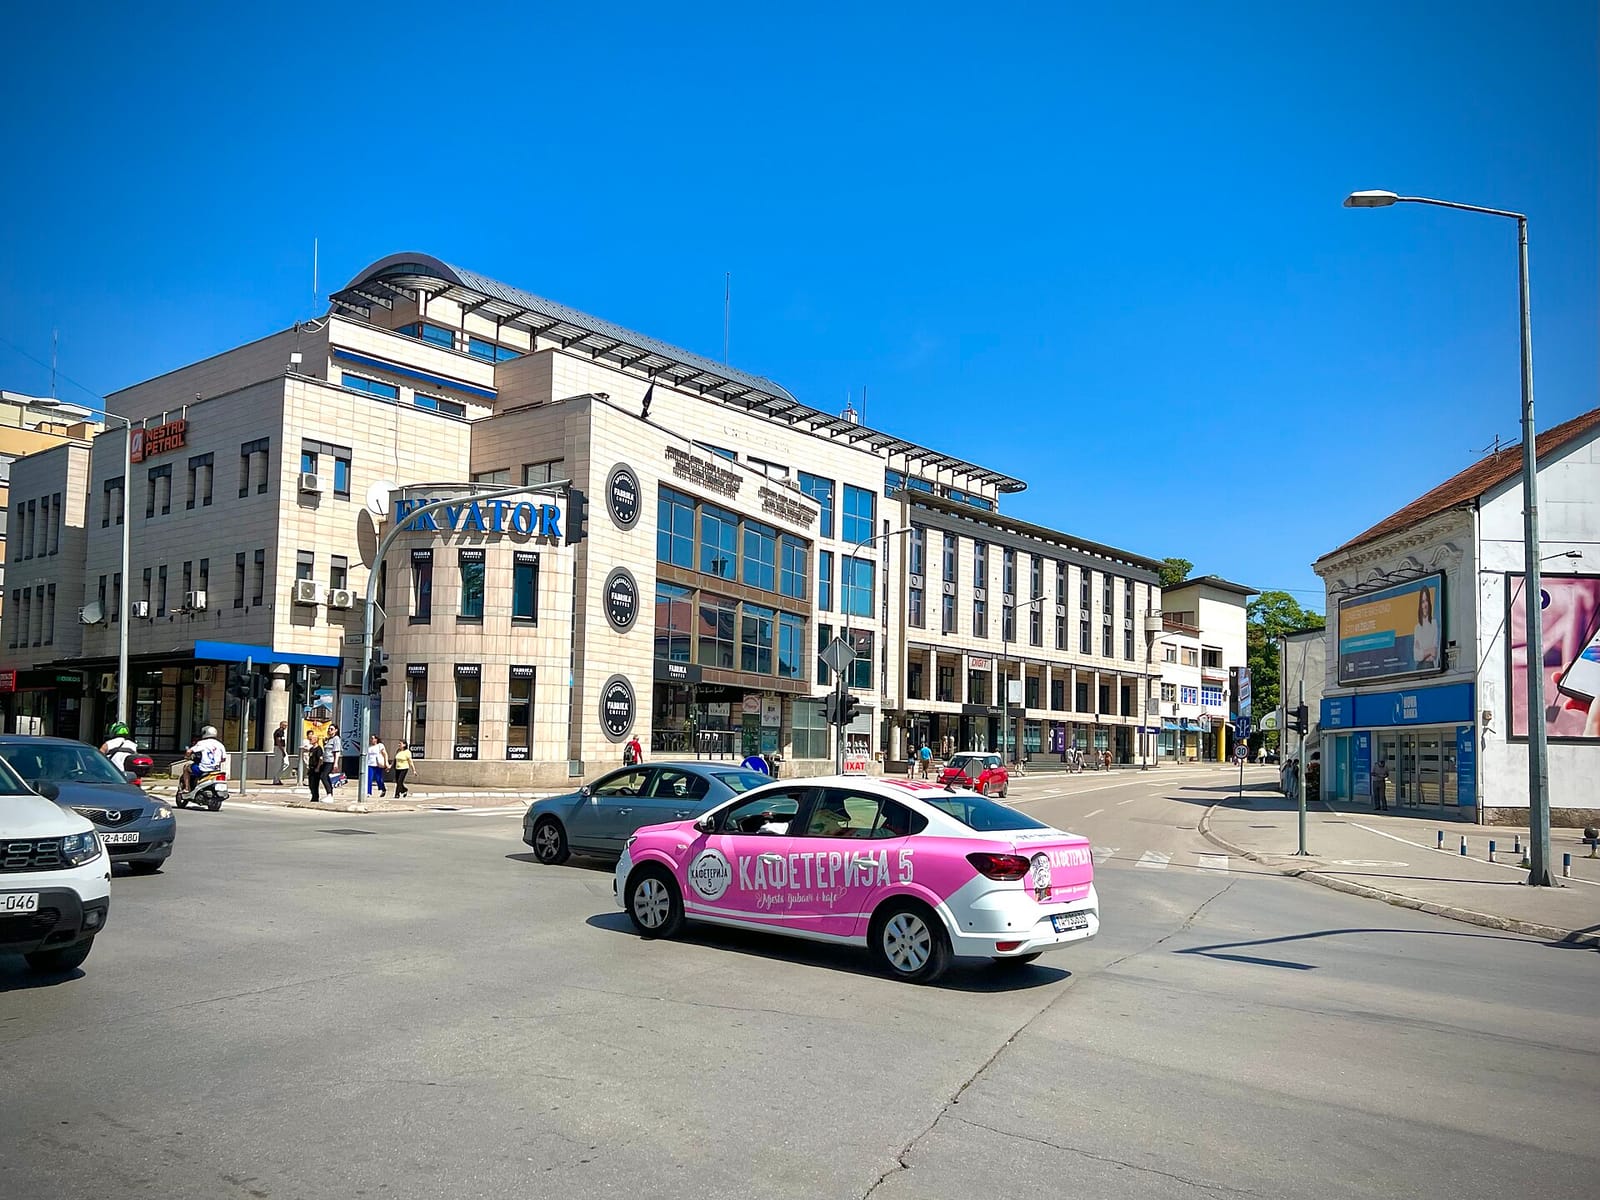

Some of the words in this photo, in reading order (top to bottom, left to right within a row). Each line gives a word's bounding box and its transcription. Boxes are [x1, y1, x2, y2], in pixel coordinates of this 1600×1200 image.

[145, 433, 185, 456] PETROL
[394, 498, 563, 537] EKVATOR
[691, 867, 728, 879] КАФЕТЕРИЈА
[739, 849, 891, 891] КАФЕТЕРИЈА
[898, 848, 915, 885] 5
[707, 879, 713, 888] 5
